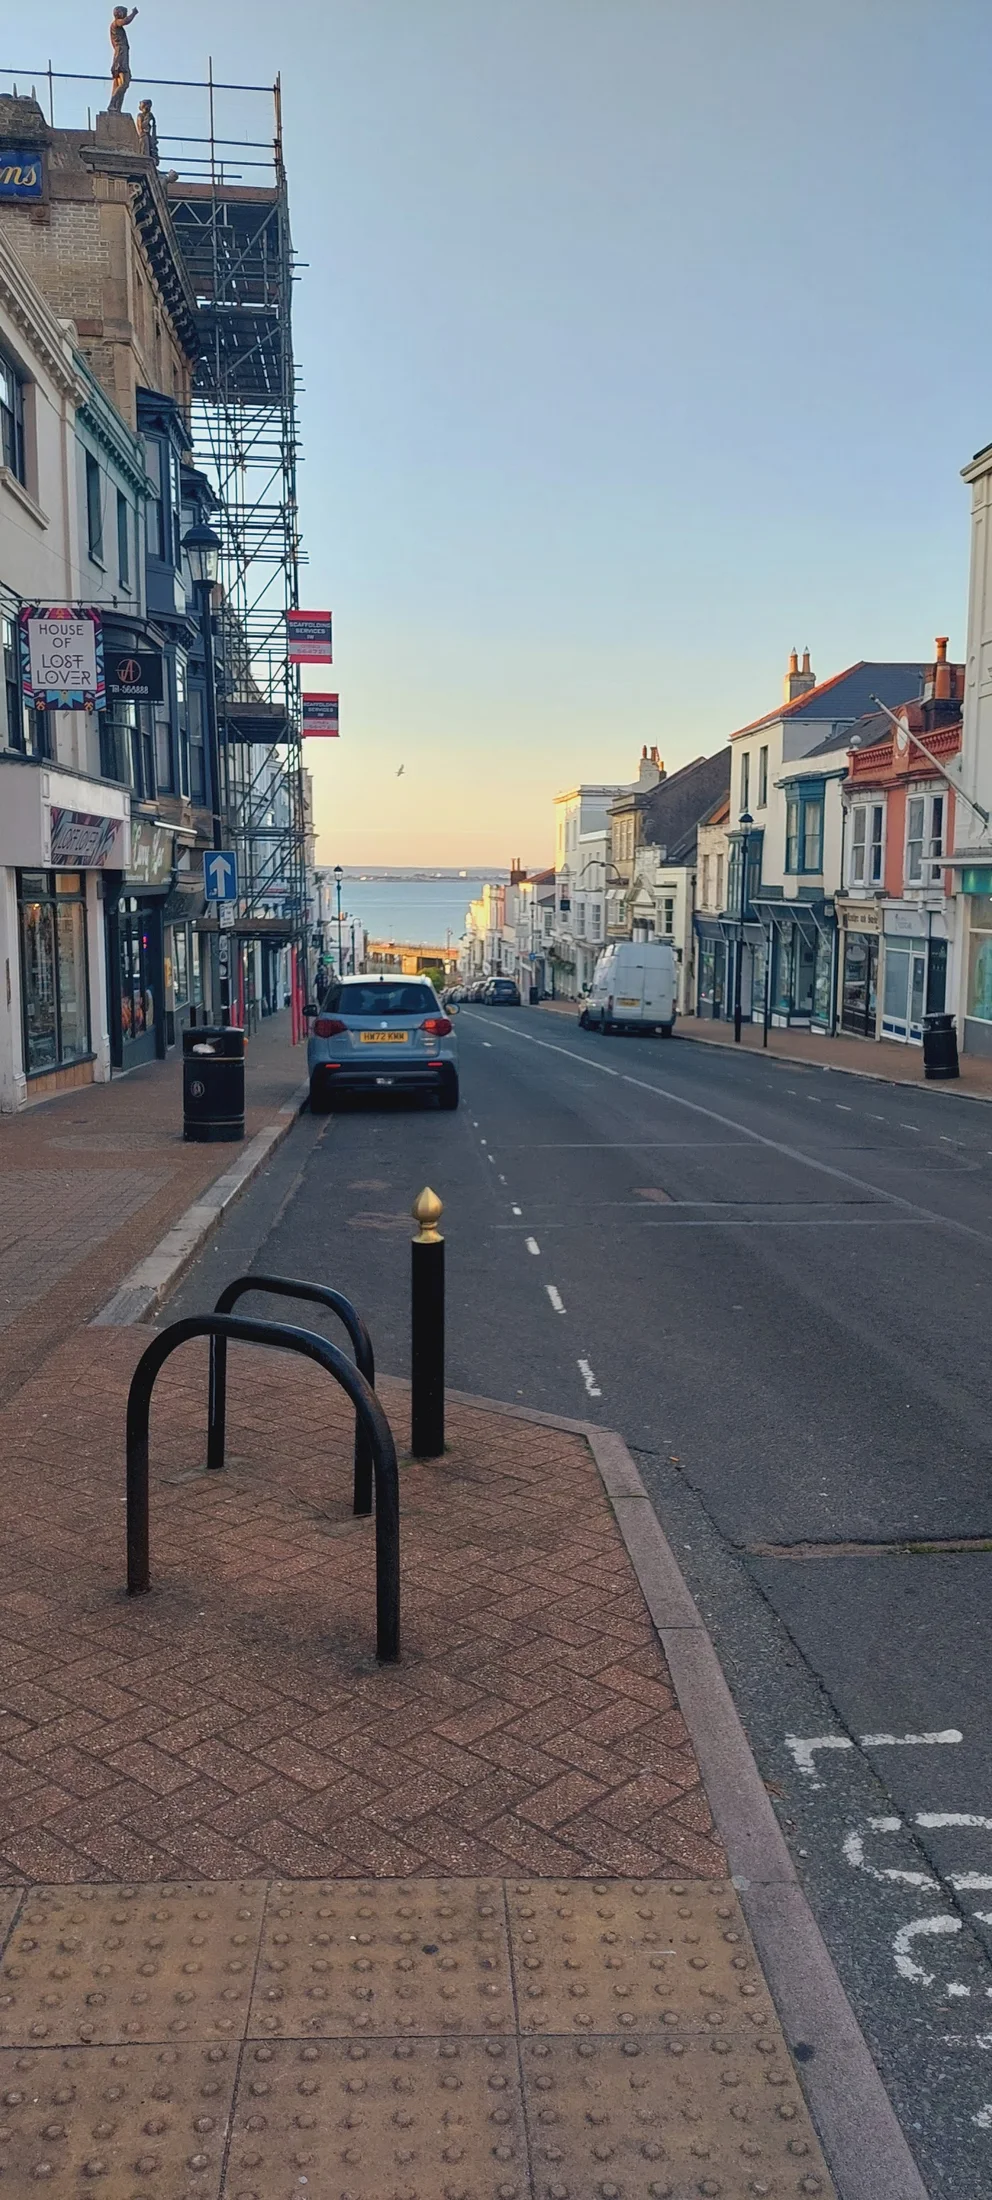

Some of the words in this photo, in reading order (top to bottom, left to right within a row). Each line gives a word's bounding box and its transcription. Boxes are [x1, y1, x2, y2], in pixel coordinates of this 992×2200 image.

[39, 624, 84, 636] HOUSE
[52, 637, 72, 648] OF
[42, 654, 84, 669] LOST
[37, 670, 91, 685] LOVER
[364, 1032, 386, 1041] HW72
